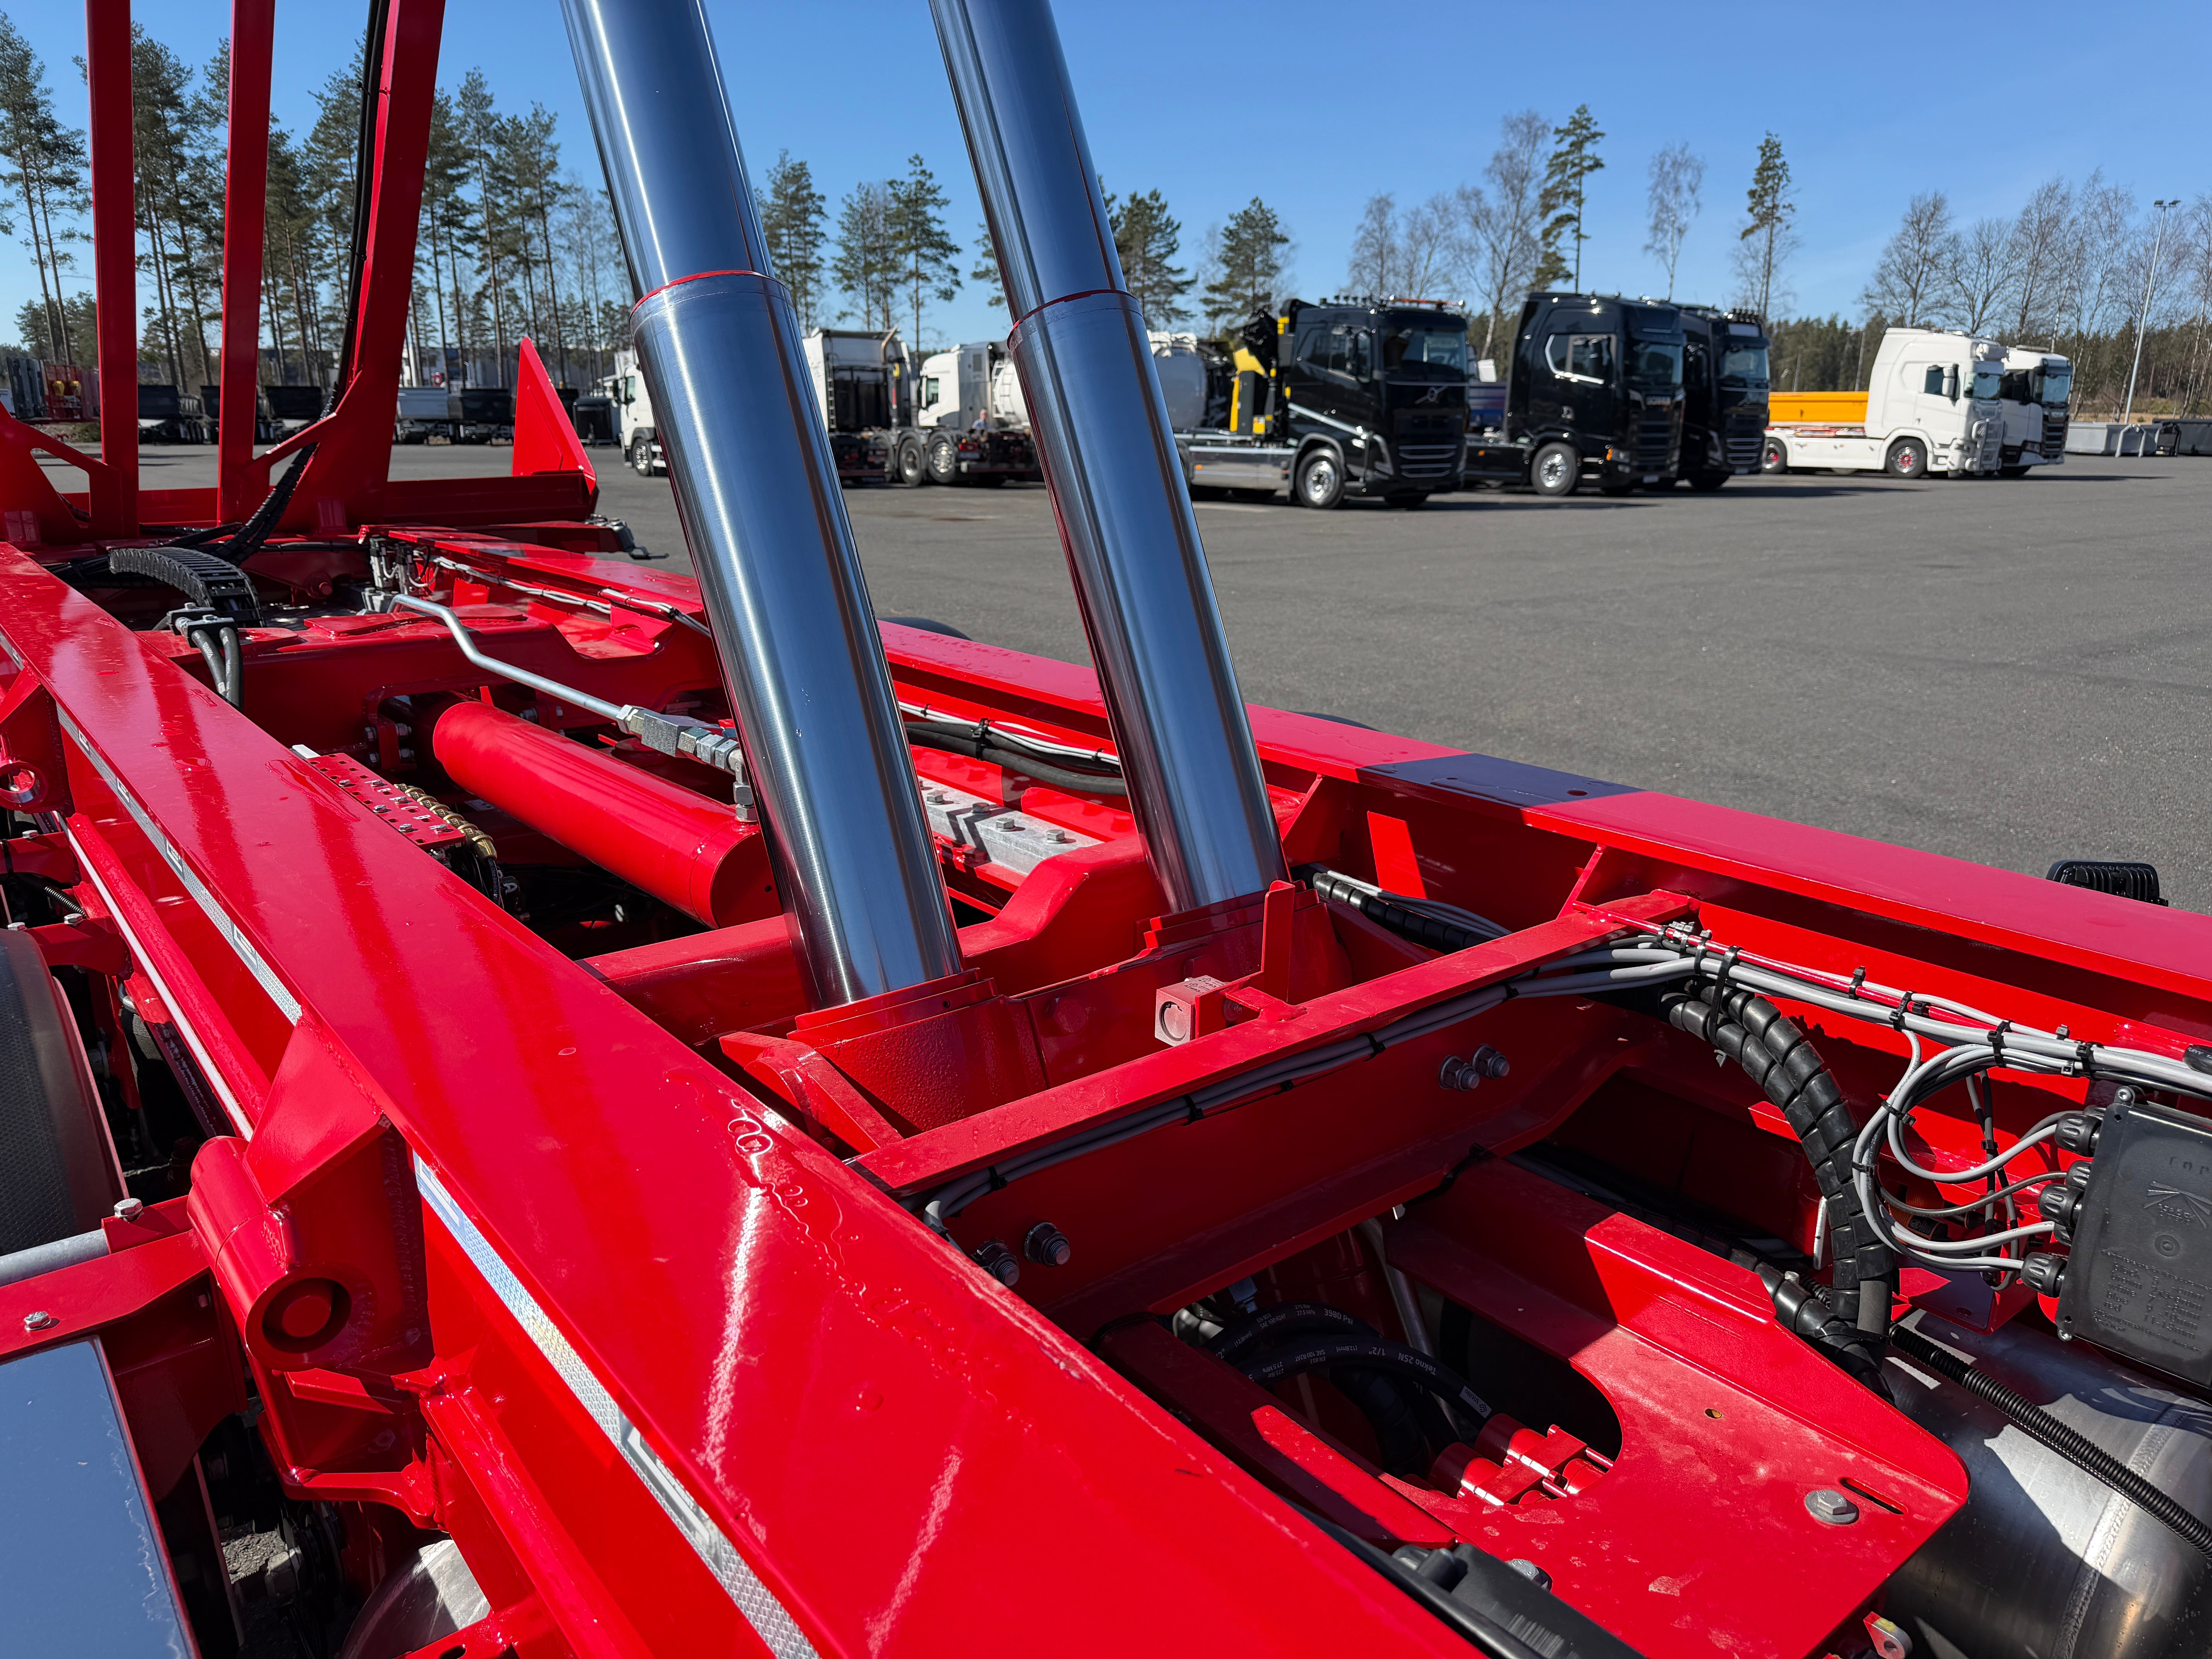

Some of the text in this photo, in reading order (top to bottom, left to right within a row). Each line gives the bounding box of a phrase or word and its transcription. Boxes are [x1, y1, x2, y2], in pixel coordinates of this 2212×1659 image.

[2107, 1290, 2129, 1304] blue
[2104, 1301, 2122, 1312] red
[1324, 1309, 1353, 1324] 3980 Psi
[1295, 1354, 1307, 1362] R2AT
[1398, 1352, 1436, 1376] Tekno 2SN
